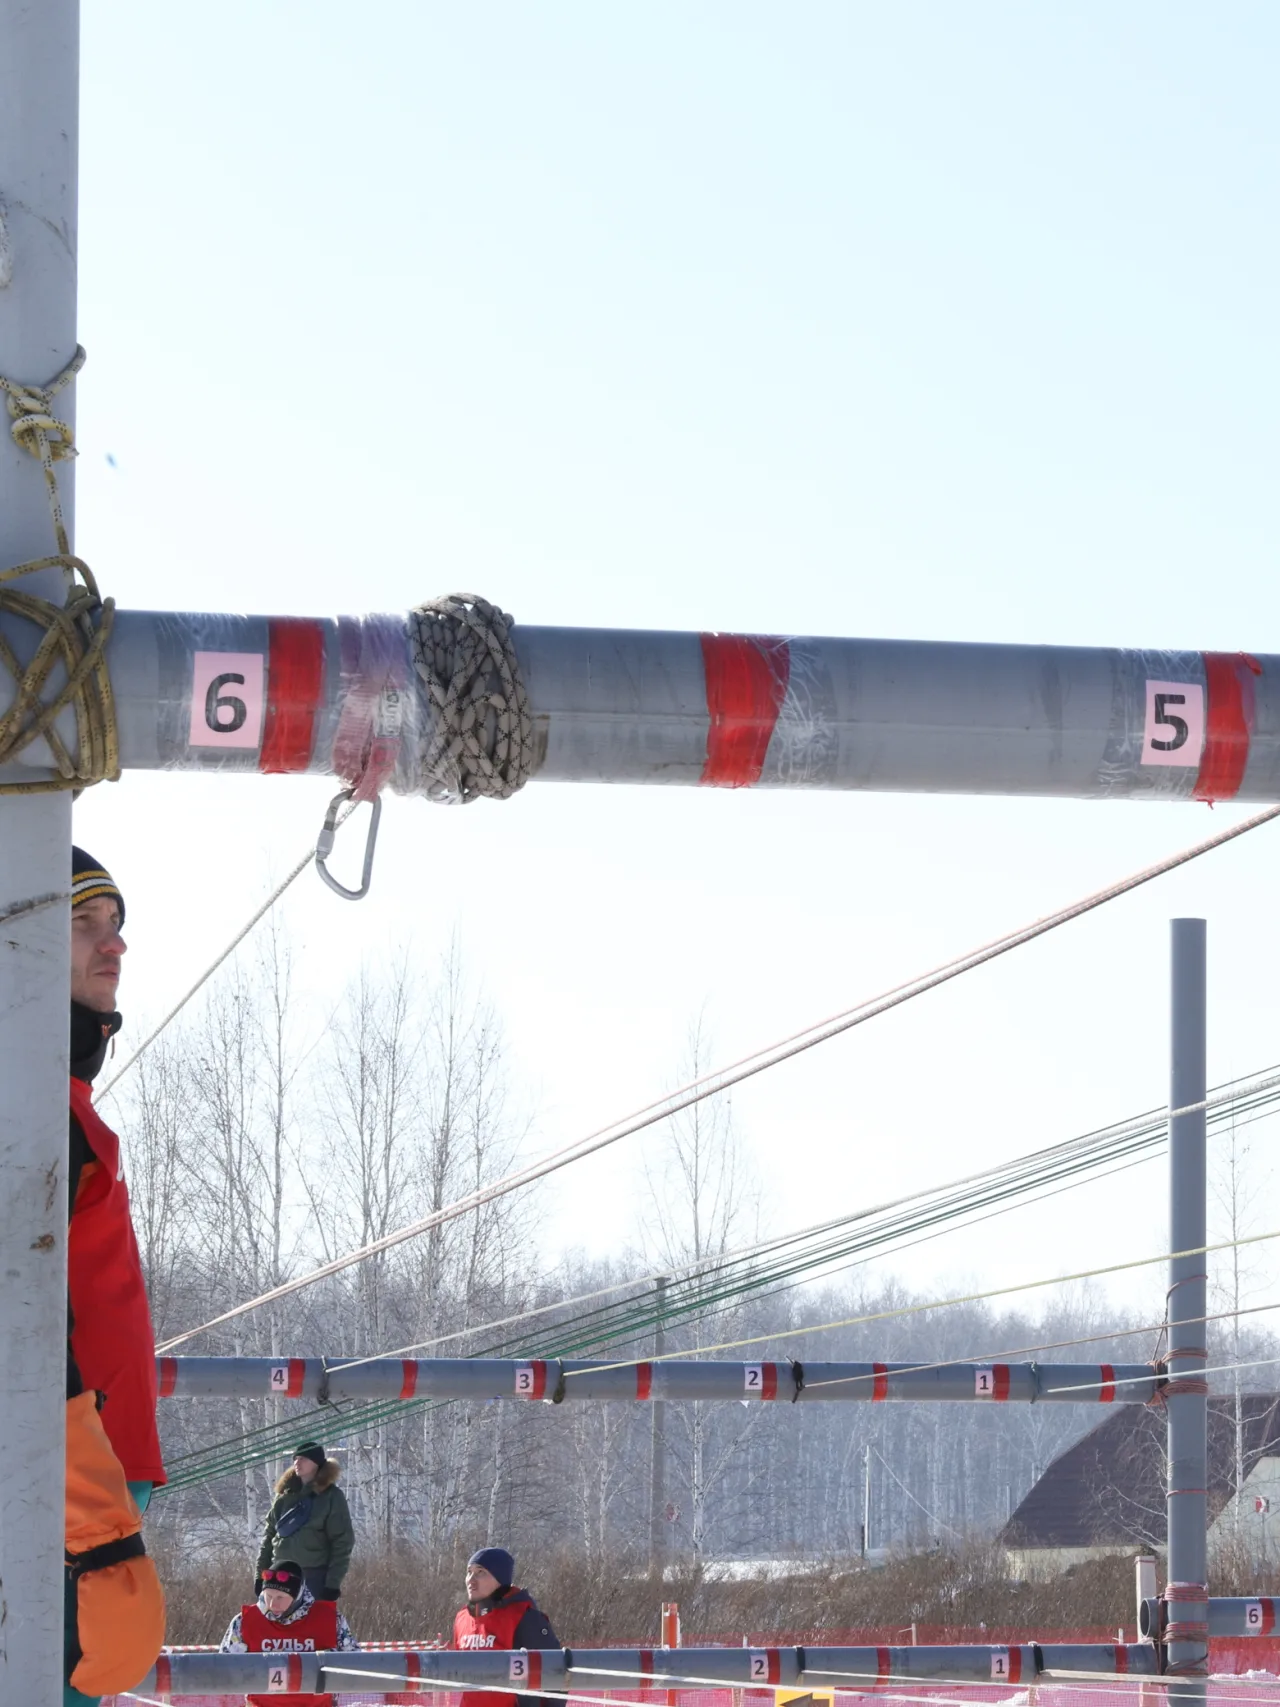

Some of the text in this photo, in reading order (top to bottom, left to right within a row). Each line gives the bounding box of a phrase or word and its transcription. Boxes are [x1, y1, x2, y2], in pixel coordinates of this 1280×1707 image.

[204, 672, 247, 734] 6
[1150, 693, 1189, 752] 5
[272, 1368, 285, 1385] 4
[519, 1373, 531, 1390] 3
[748, 1370, 759, 1386] 2
[979, 1374, 989, 1390] 1
[1248, 1607, 1259, 1624] 6
[261, 1638, 315, 1652] СУДЬЯ
[459, 1634, 496, 1649] СУДЬЯ
[513, 1659, 525, 1676] 3
[754, 1659, 765, 1675] 2
[995, 1658, 1006, 1674] 1
[270, 1670, 284, 1686] 4
